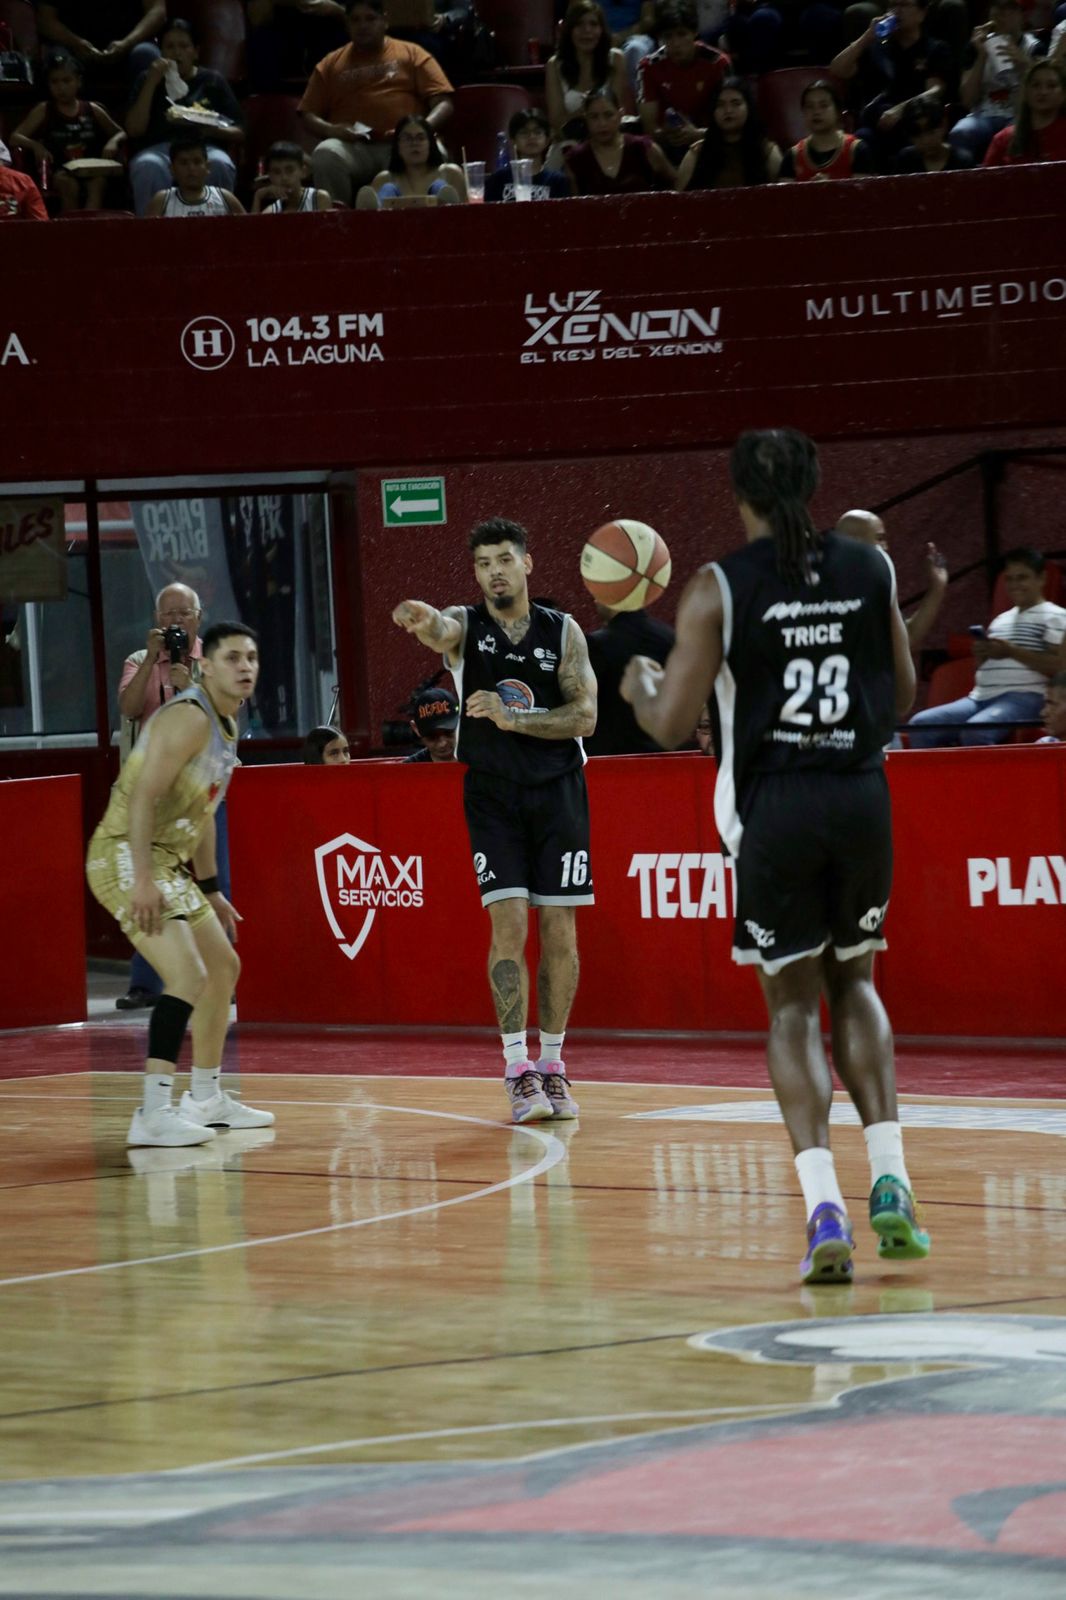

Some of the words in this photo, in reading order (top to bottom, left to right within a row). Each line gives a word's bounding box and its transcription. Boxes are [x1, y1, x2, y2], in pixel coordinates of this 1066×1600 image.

[524, 289, 602, 314] LUZ
[806, 278, 1066, 321] MULTIMEDIO
[246, 315, 330, 342] 104.3
[338, 313, 384, 338] FM
[522, 307, 721, 346] XENON
[191, 329, 225, 357] H
[247, 347, 280, 367] LA
[287, 343, 384, 365] LAGUNA
[520, 352, 546, 364] EL
[552, 349, 596, 362] REY
[602, 347, 641, 360] DEL
[0, 506, 54, 553] LES
[781, 623, 843, 648] TRICE
[780, 655, 850, 726] 23
[336, 854, 423, 890] MAXI
[561, 850, 588, 888] 16
[338, 889, 424, 907] SERVICIOS
